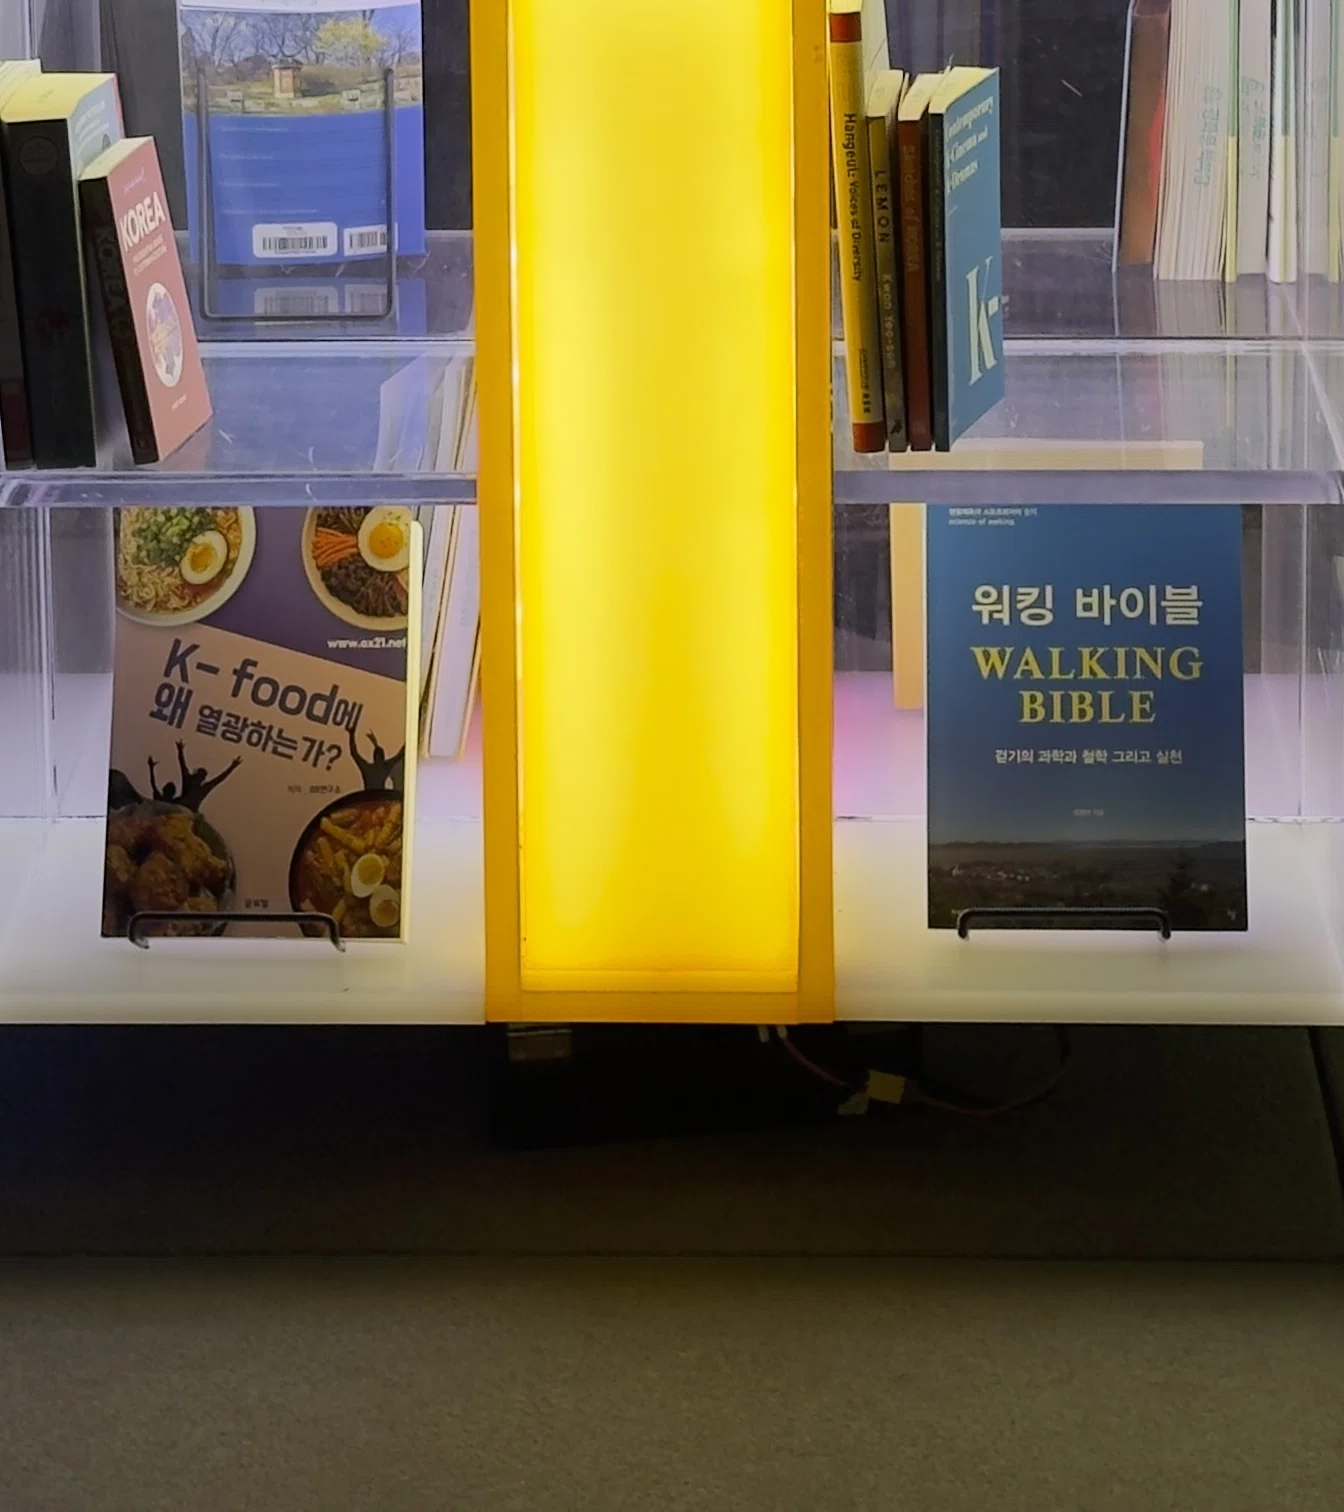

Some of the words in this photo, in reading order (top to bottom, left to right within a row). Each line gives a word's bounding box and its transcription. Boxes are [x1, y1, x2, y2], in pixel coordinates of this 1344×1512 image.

[118, 191, 167, 253] KOREA
[874, 169, 893, 245] LEMON
[965, 255, 999, 387] K-
[971, 584, 1055, 627] 워킹
[1075, 584, 1204, 627] 바이블
[163, 637, 221, 684] K-
[230, 657, 365, 733] food에
[969, 645, 1204, 680] WALKING
[149, 682, 194, 730] 왜
[195, 703, 345, 773] 열광하는가?
[1018, 690, 1157, 724] BIBLE
[994, 748, 1035, 765] 걷기의
[1037, 748, 1078, 765] 과학과
[1111, 749, 1153, 764] 그리고
